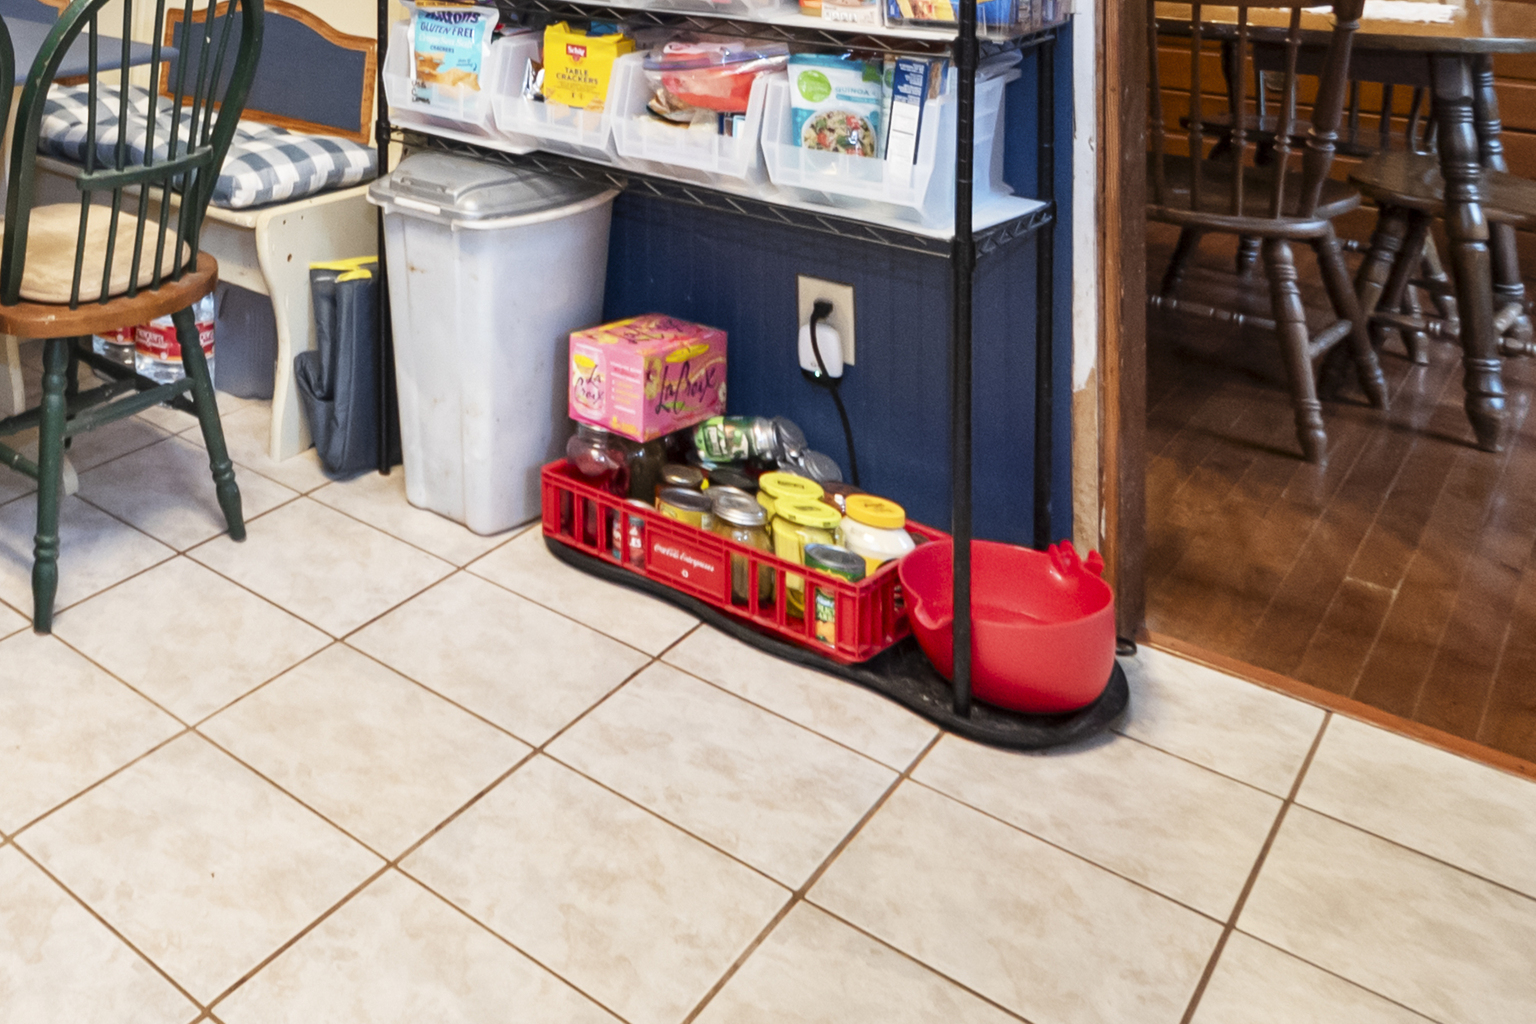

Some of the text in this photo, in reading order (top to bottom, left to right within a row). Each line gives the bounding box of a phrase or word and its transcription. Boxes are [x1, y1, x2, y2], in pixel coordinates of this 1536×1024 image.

[421, 22, 451, 35] GLUTEN
[565, 67, 588, 75] TABLE
[556, 73, 598, 85] CRACKERS
[835, 86, 870, 95] QUINOA
